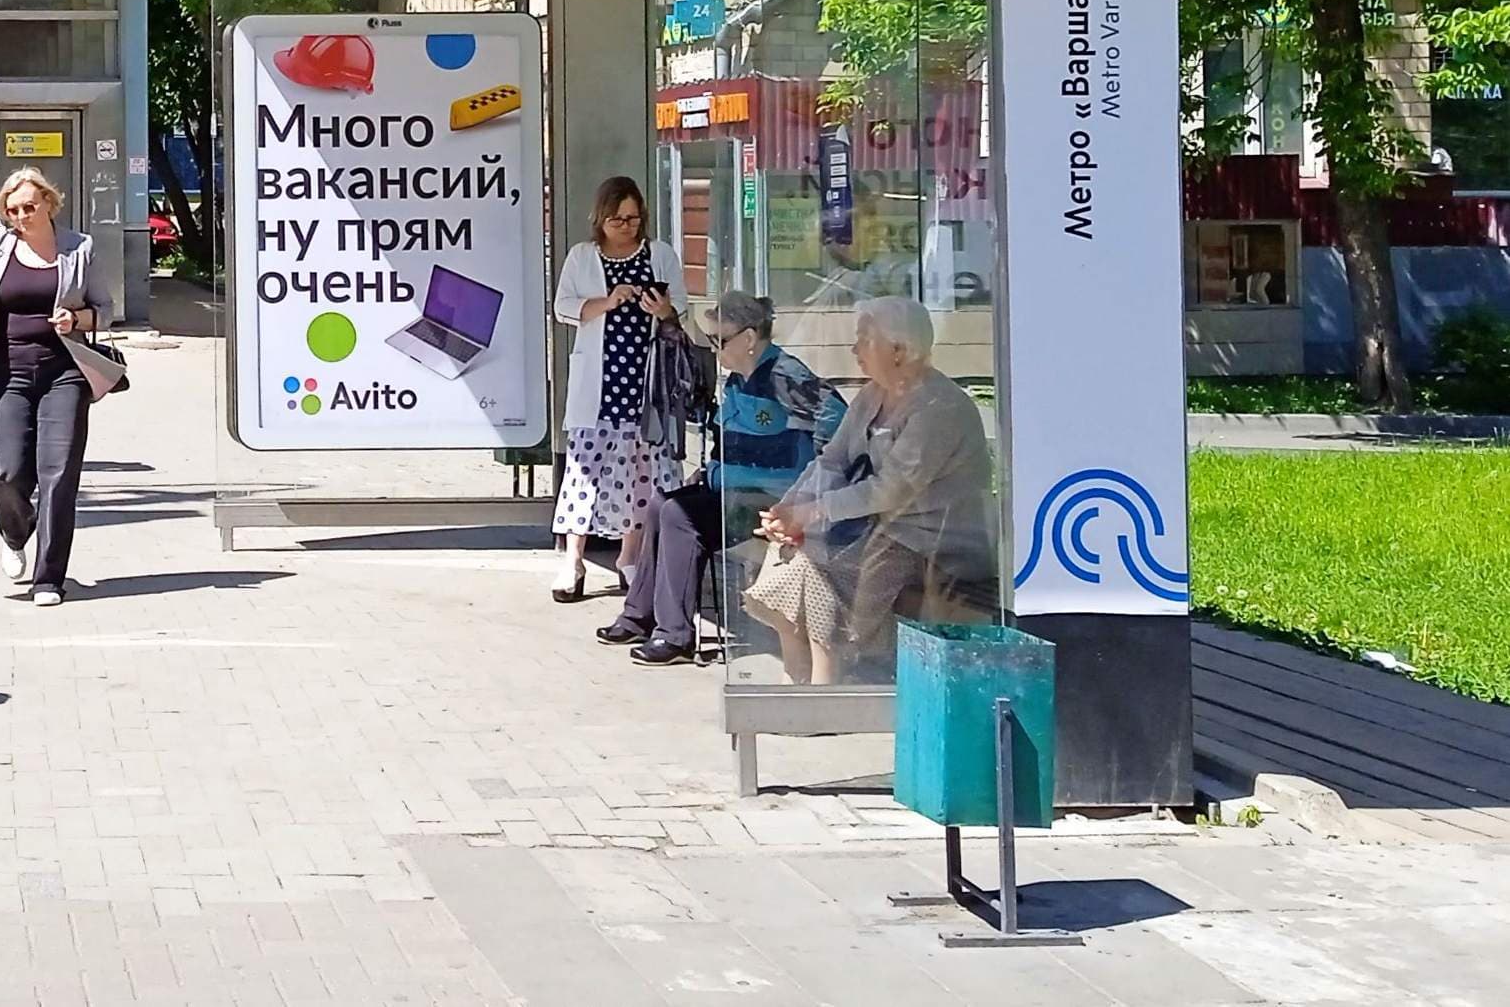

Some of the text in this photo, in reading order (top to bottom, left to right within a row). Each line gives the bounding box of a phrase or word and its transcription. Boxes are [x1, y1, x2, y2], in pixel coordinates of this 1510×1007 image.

[693, 5, 710, 17] 24
[1100, 46, 1122, 119] Metro
[257, 104, 433, 148] Много
[257, 154, 521, 207] вакансий,
[1063, 130, 1098, 240] Метро
[258, 218, 473, 261] ну прям
[256, 269, 415, 304] очень
[330, 380, 418, 411] Avito
[479, 396, 497, 409] 6+
